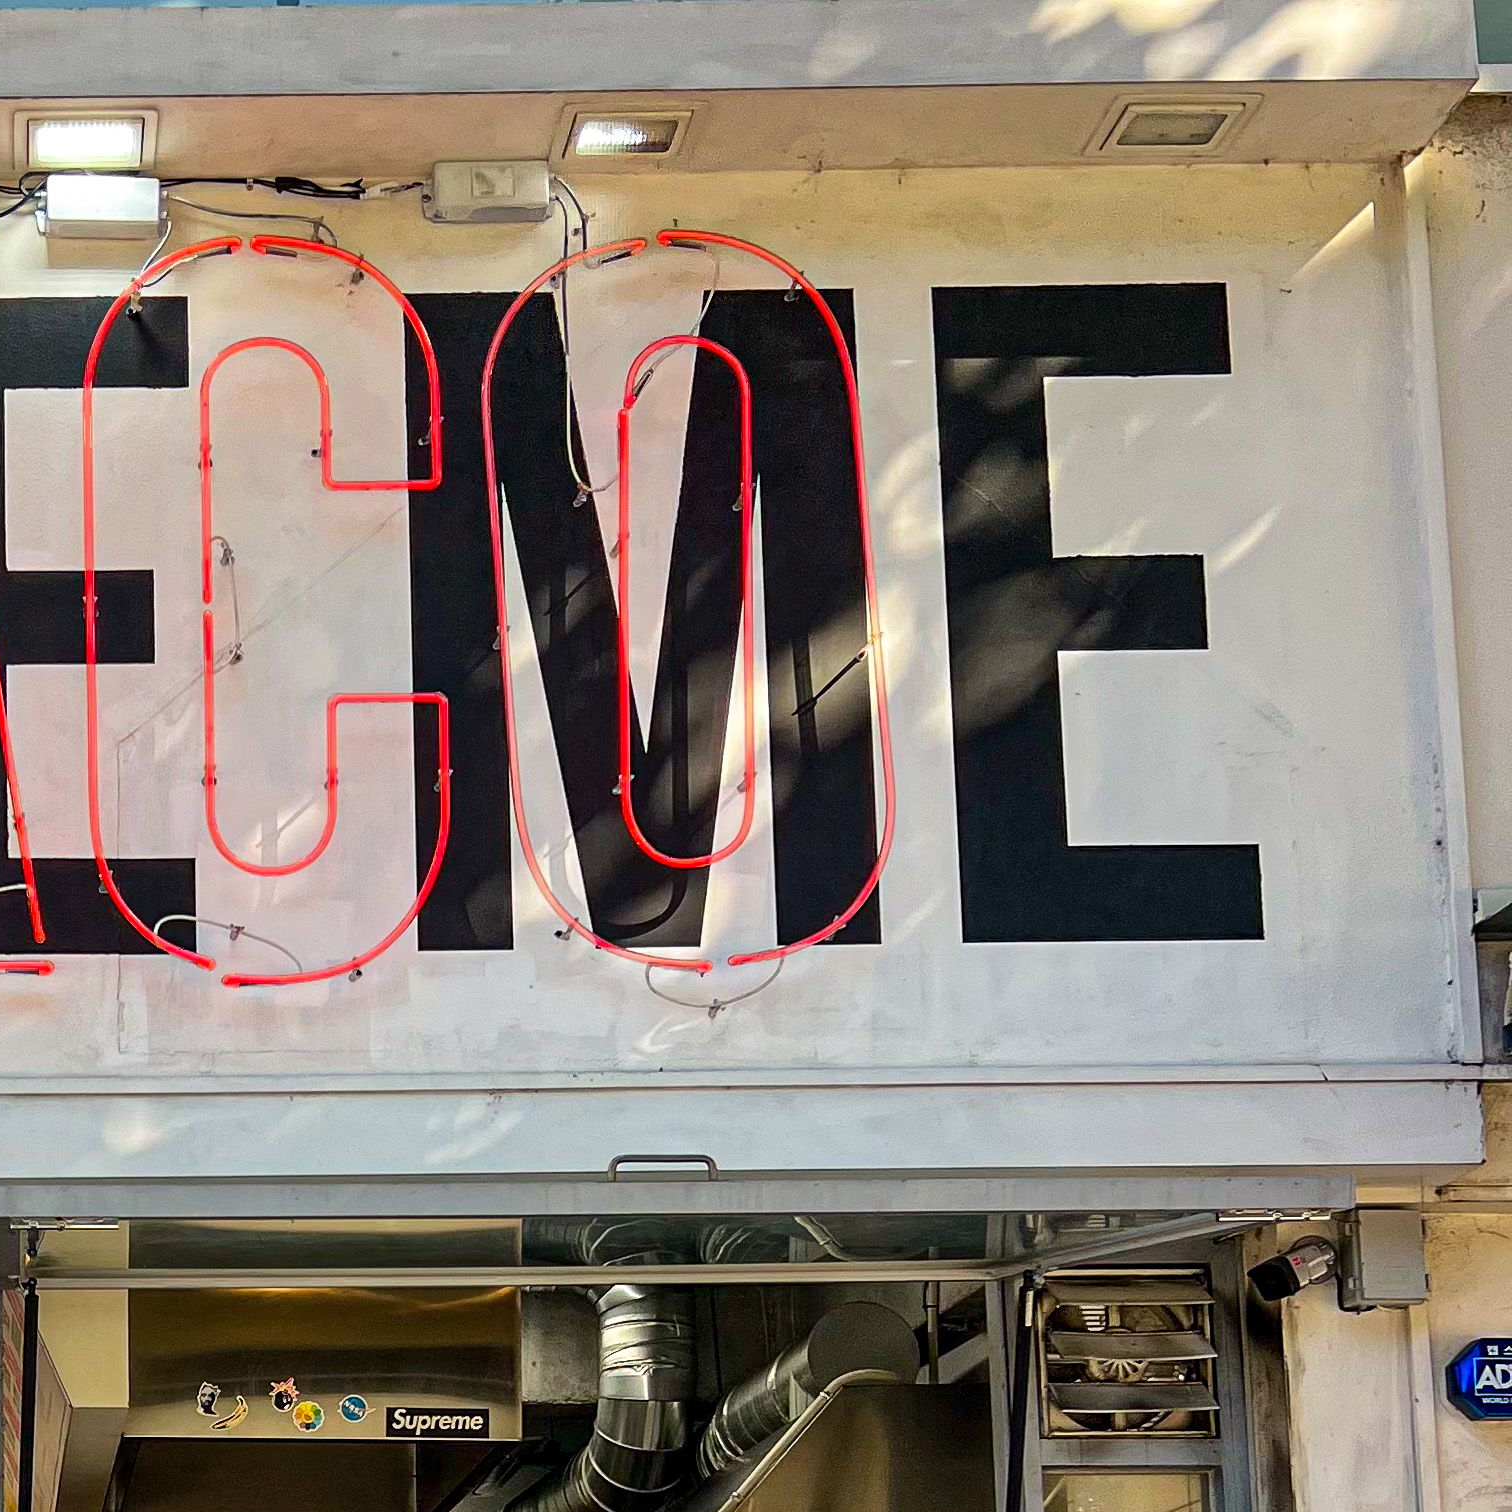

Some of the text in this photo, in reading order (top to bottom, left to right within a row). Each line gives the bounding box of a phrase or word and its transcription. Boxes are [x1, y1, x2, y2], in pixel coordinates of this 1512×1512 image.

[404, 282, 1265, 952] ME
[1475, 1363, 1512, 1389] AD
[392, 1408, 484, 1436] Supreme
